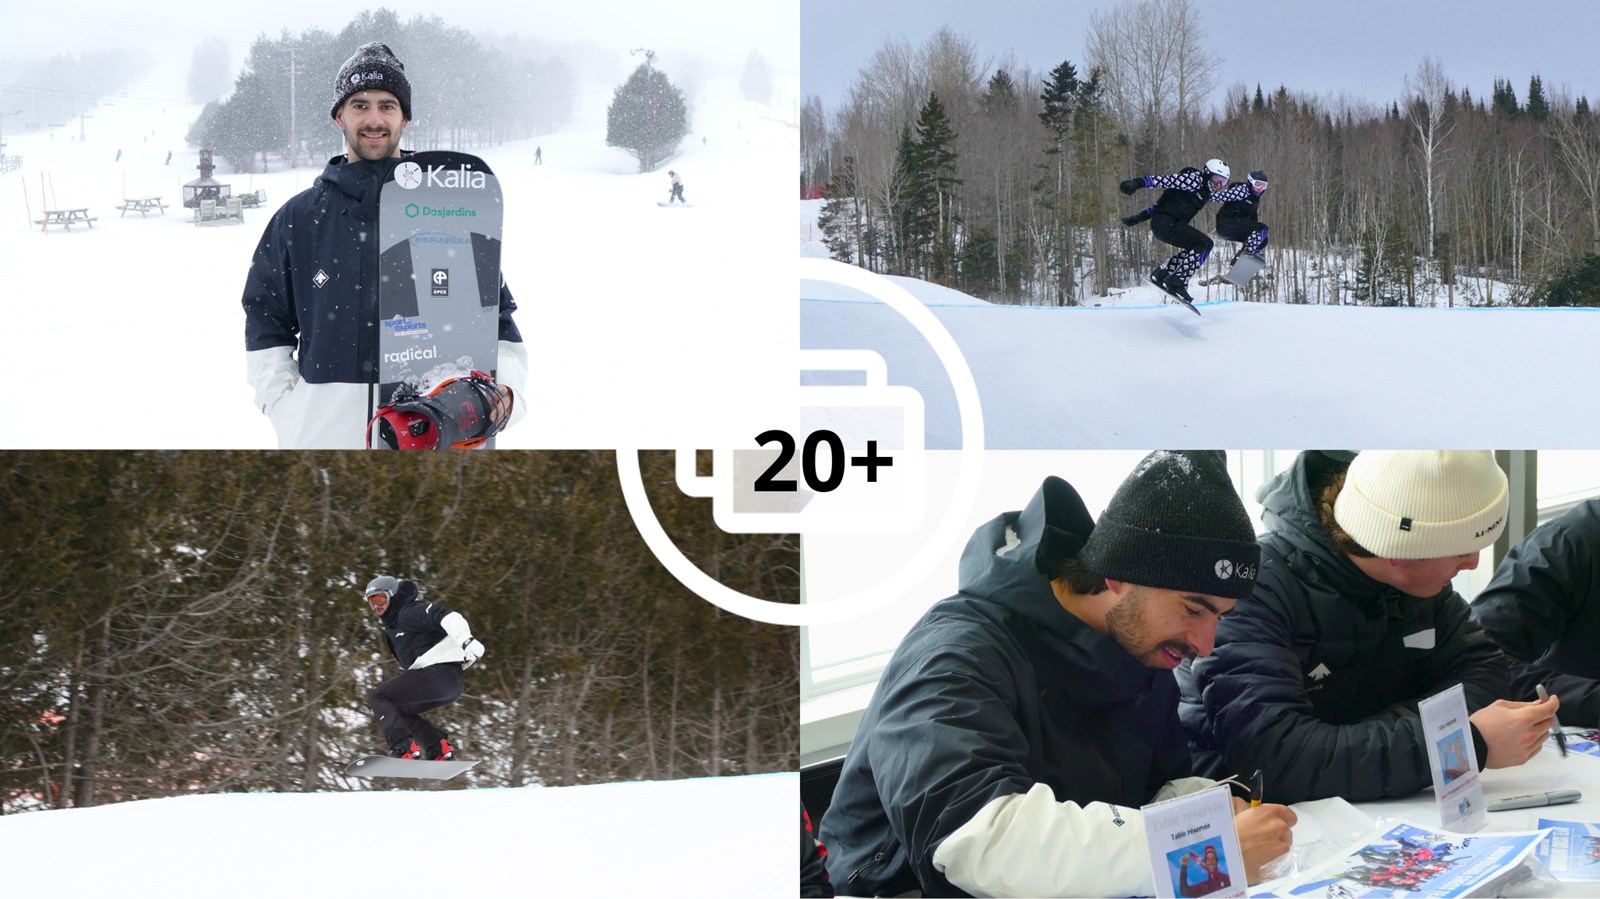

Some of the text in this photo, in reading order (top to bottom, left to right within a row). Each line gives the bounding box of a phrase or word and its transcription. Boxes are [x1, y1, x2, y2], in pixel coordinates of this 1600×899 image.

[361, 71, 383, 80] Kalia
[427, 164, 486, 189] Kalia
[422, 205, 477, 218] Desjardins
[384, 344, 437, 363] radical
[1170, 831, 1186, 841] Table
